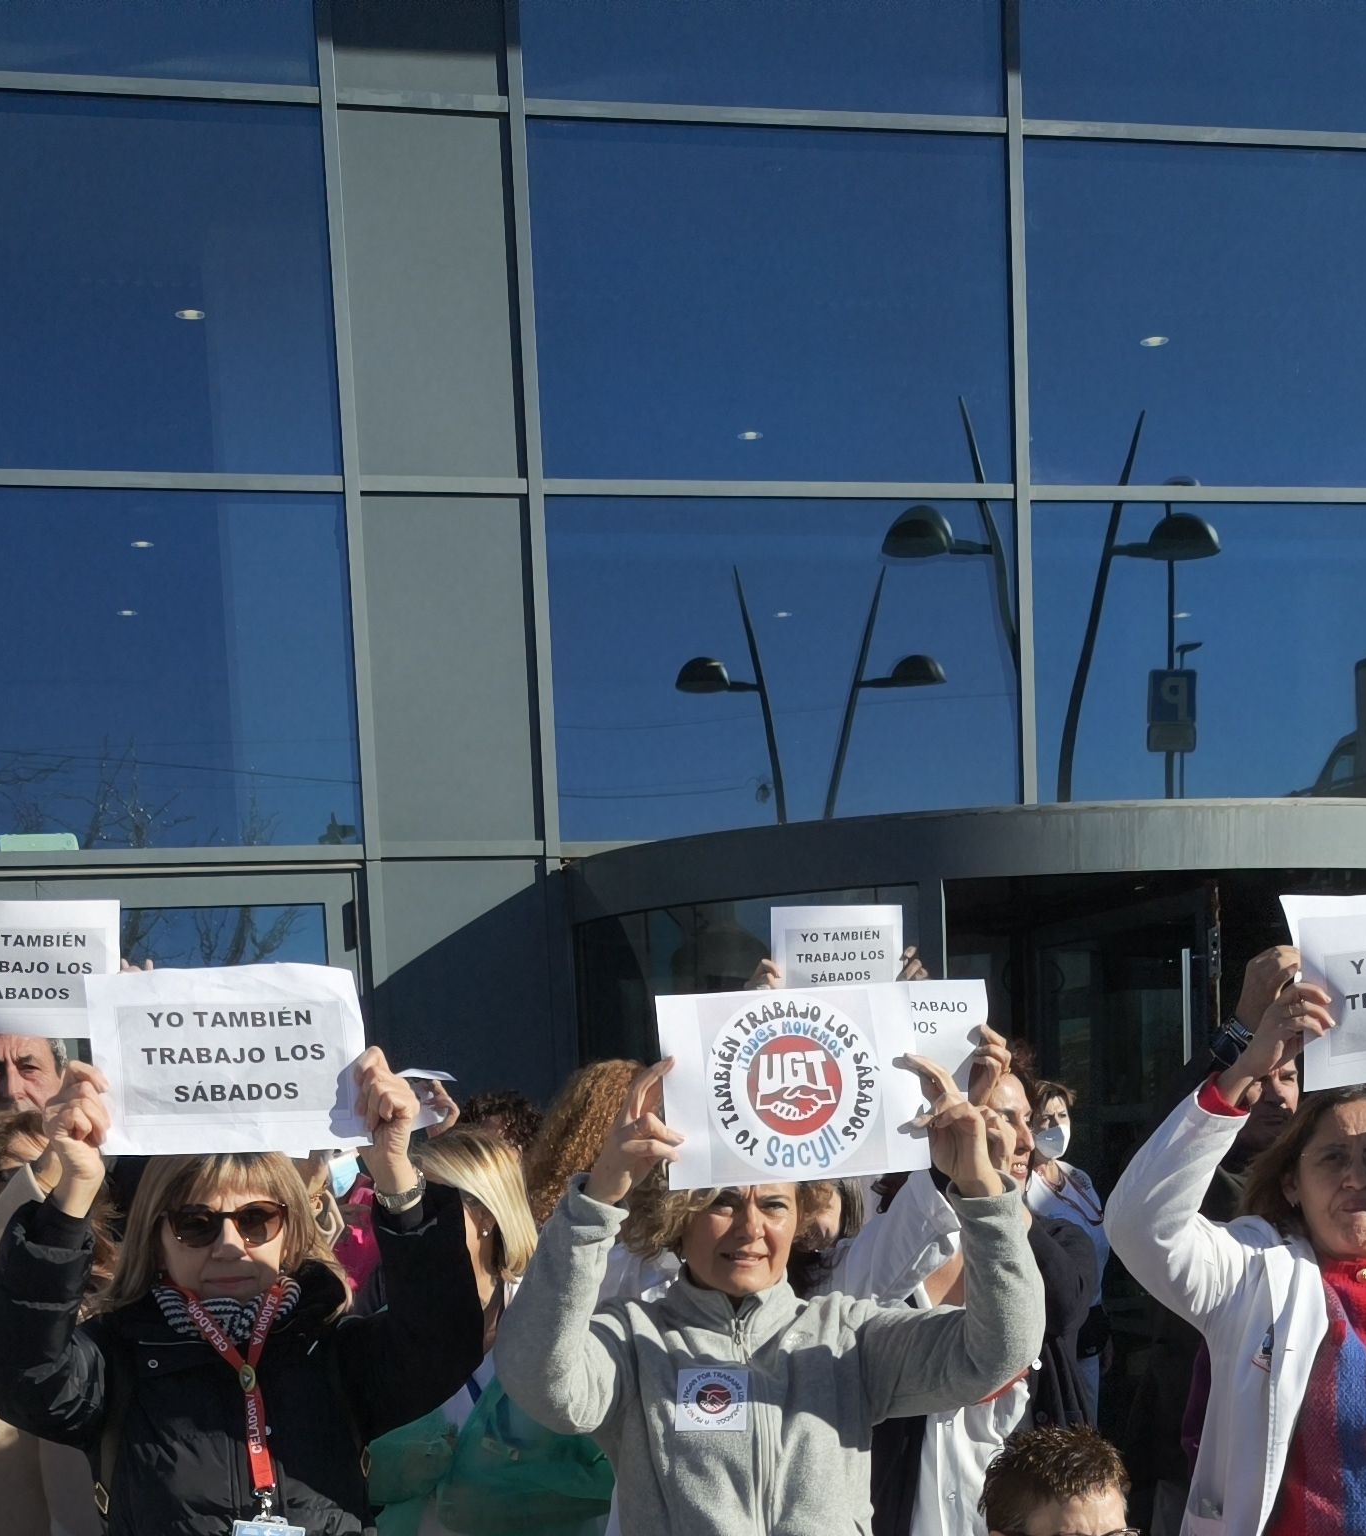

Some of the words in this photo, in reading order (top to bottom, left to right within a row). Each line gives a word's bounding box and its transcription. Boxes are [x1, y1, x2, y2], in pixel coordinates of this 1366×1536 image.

[0, 930, 87, 949] TAMBIÉN
[801, 932, 819, 943] YO
[823, 928, 880, 942] TAMBIÉN
[796, 951, 856, 963] TRABAJO
[860, 950, 885, 961] LOS
[55, 960, 93, 976] LOS
[810, 970, 871, 983] SÁBADOS
[146, 1011, 184, 1029] YO
[192, 1006, 312, 1028] TAMBIÉN
[910, 1001, 968, 1013] RABAJO
[781, 1021, 845, 1059] MOVEMOS
[141, 1045, 267, 1066] TRABAJO
[275, 1043, 326, 1062] LOS
[758, 1050, 827, 1093] UGT
[173, 1078, 300, 1103] SÁBADOS
[735, 1129, 759, 1156] YO
[824, 1014, 858, 1048] LOS
[841, 1051, 881, 1141] SÁBADOS
